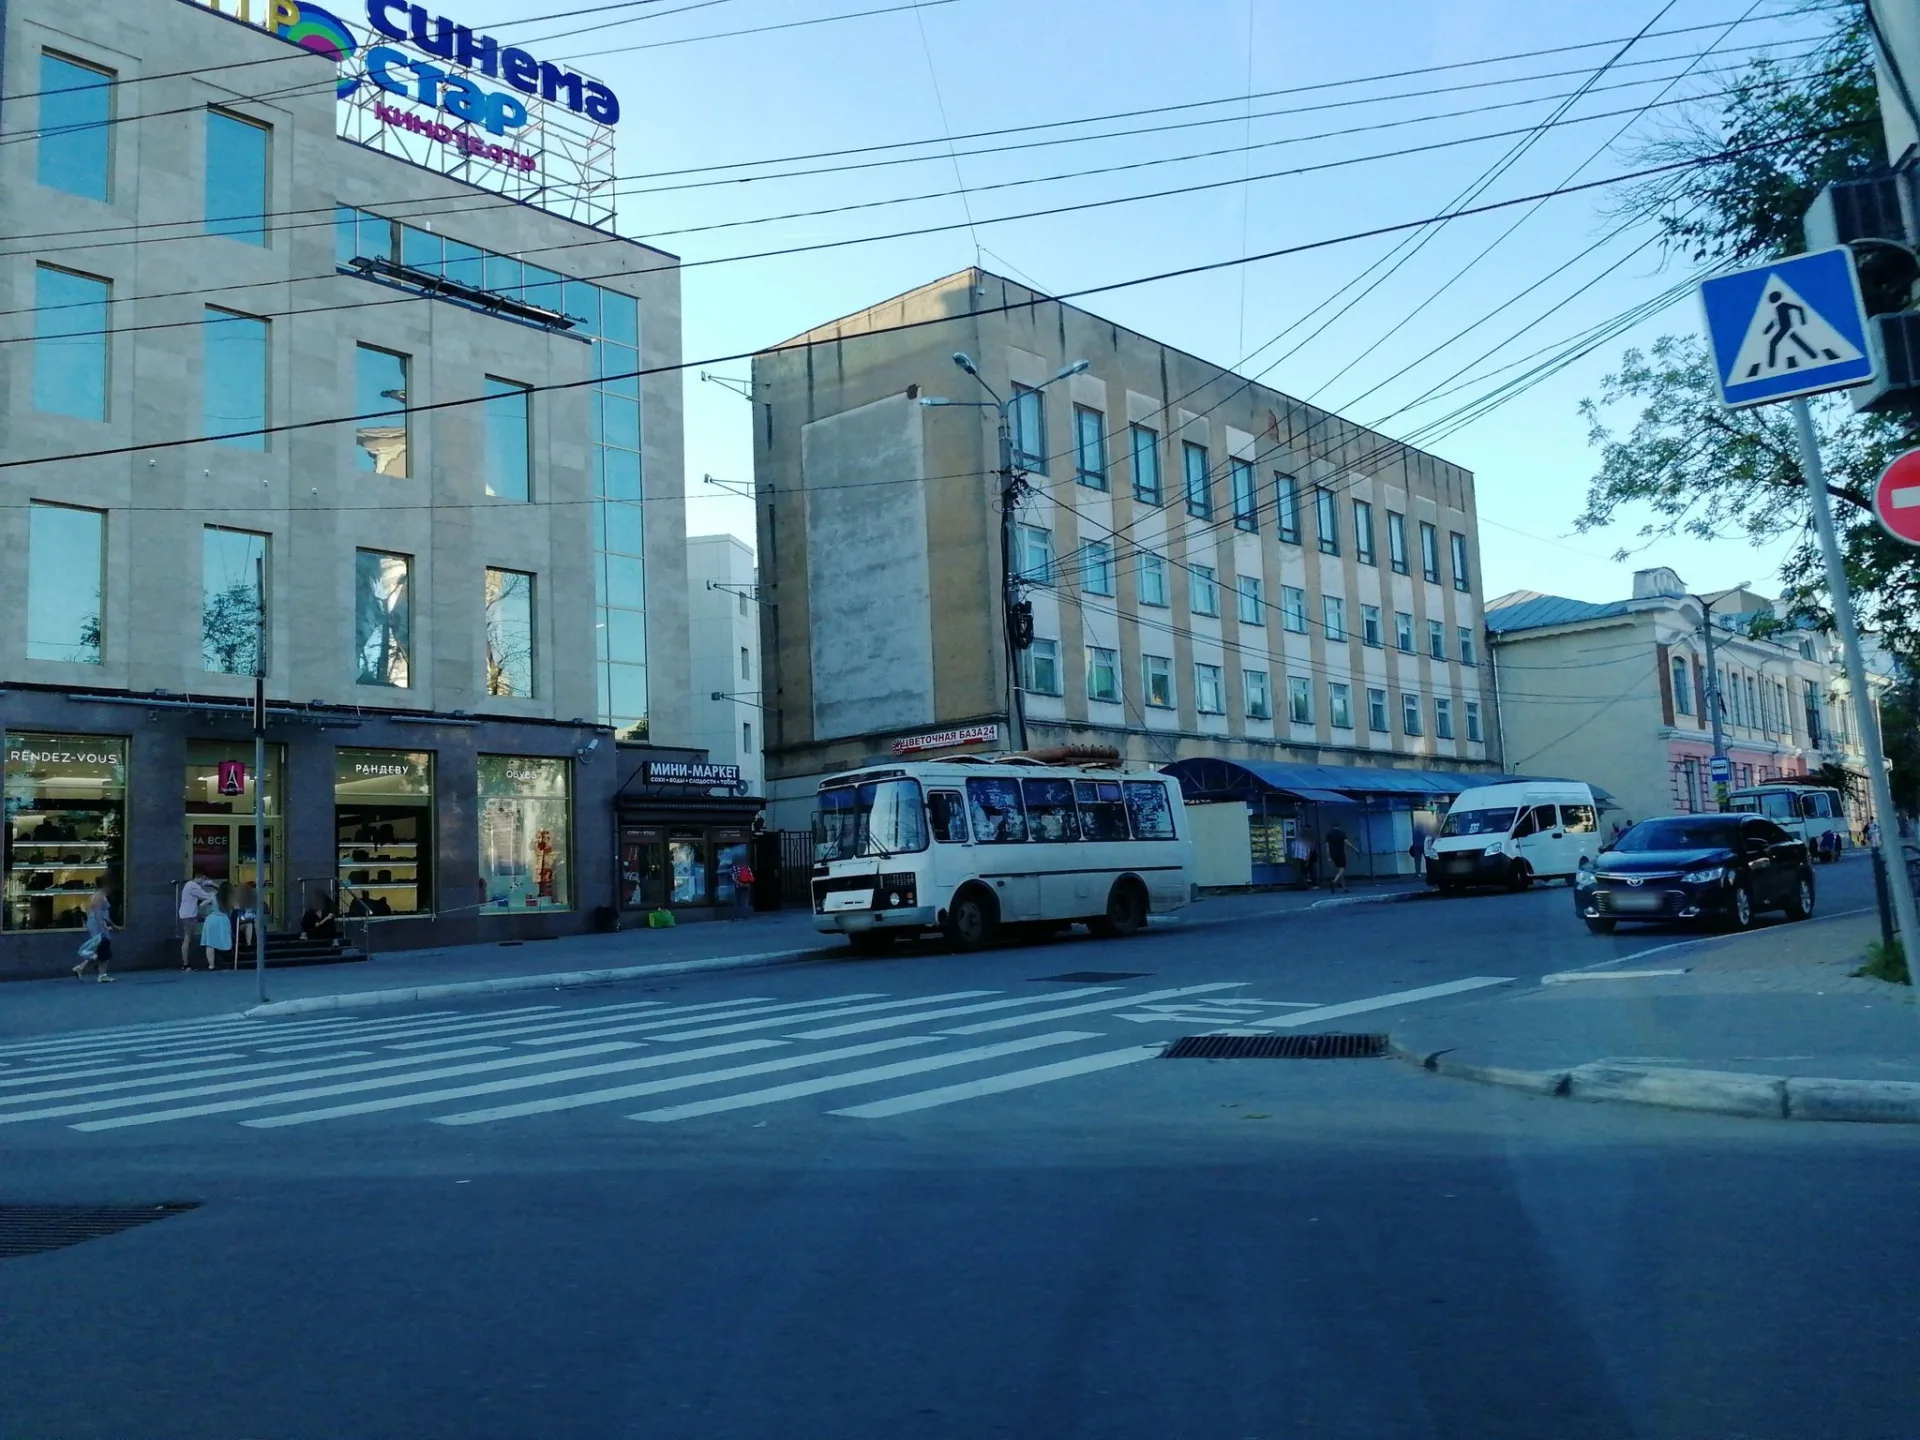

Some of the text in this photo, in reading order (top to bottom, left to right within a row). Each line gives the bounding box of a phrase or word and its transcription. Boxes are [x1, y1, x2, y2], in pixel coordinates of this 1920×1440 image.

[374, 100, 536, 171] КИНОТЕАТР
[902, 731, 957, 748] ЦВЕТОЧНАЯ
[10, 750, 118, 764] RENDEZ-VOUS
[355, 763, 409, 775] РАНДЕВУ
[505, 769, 538, 779] ОБУВЬ
[650, 762, 738, 778] МИНИ-МАРКЕТ
[207, 836, 228, 845] ВСЕ
